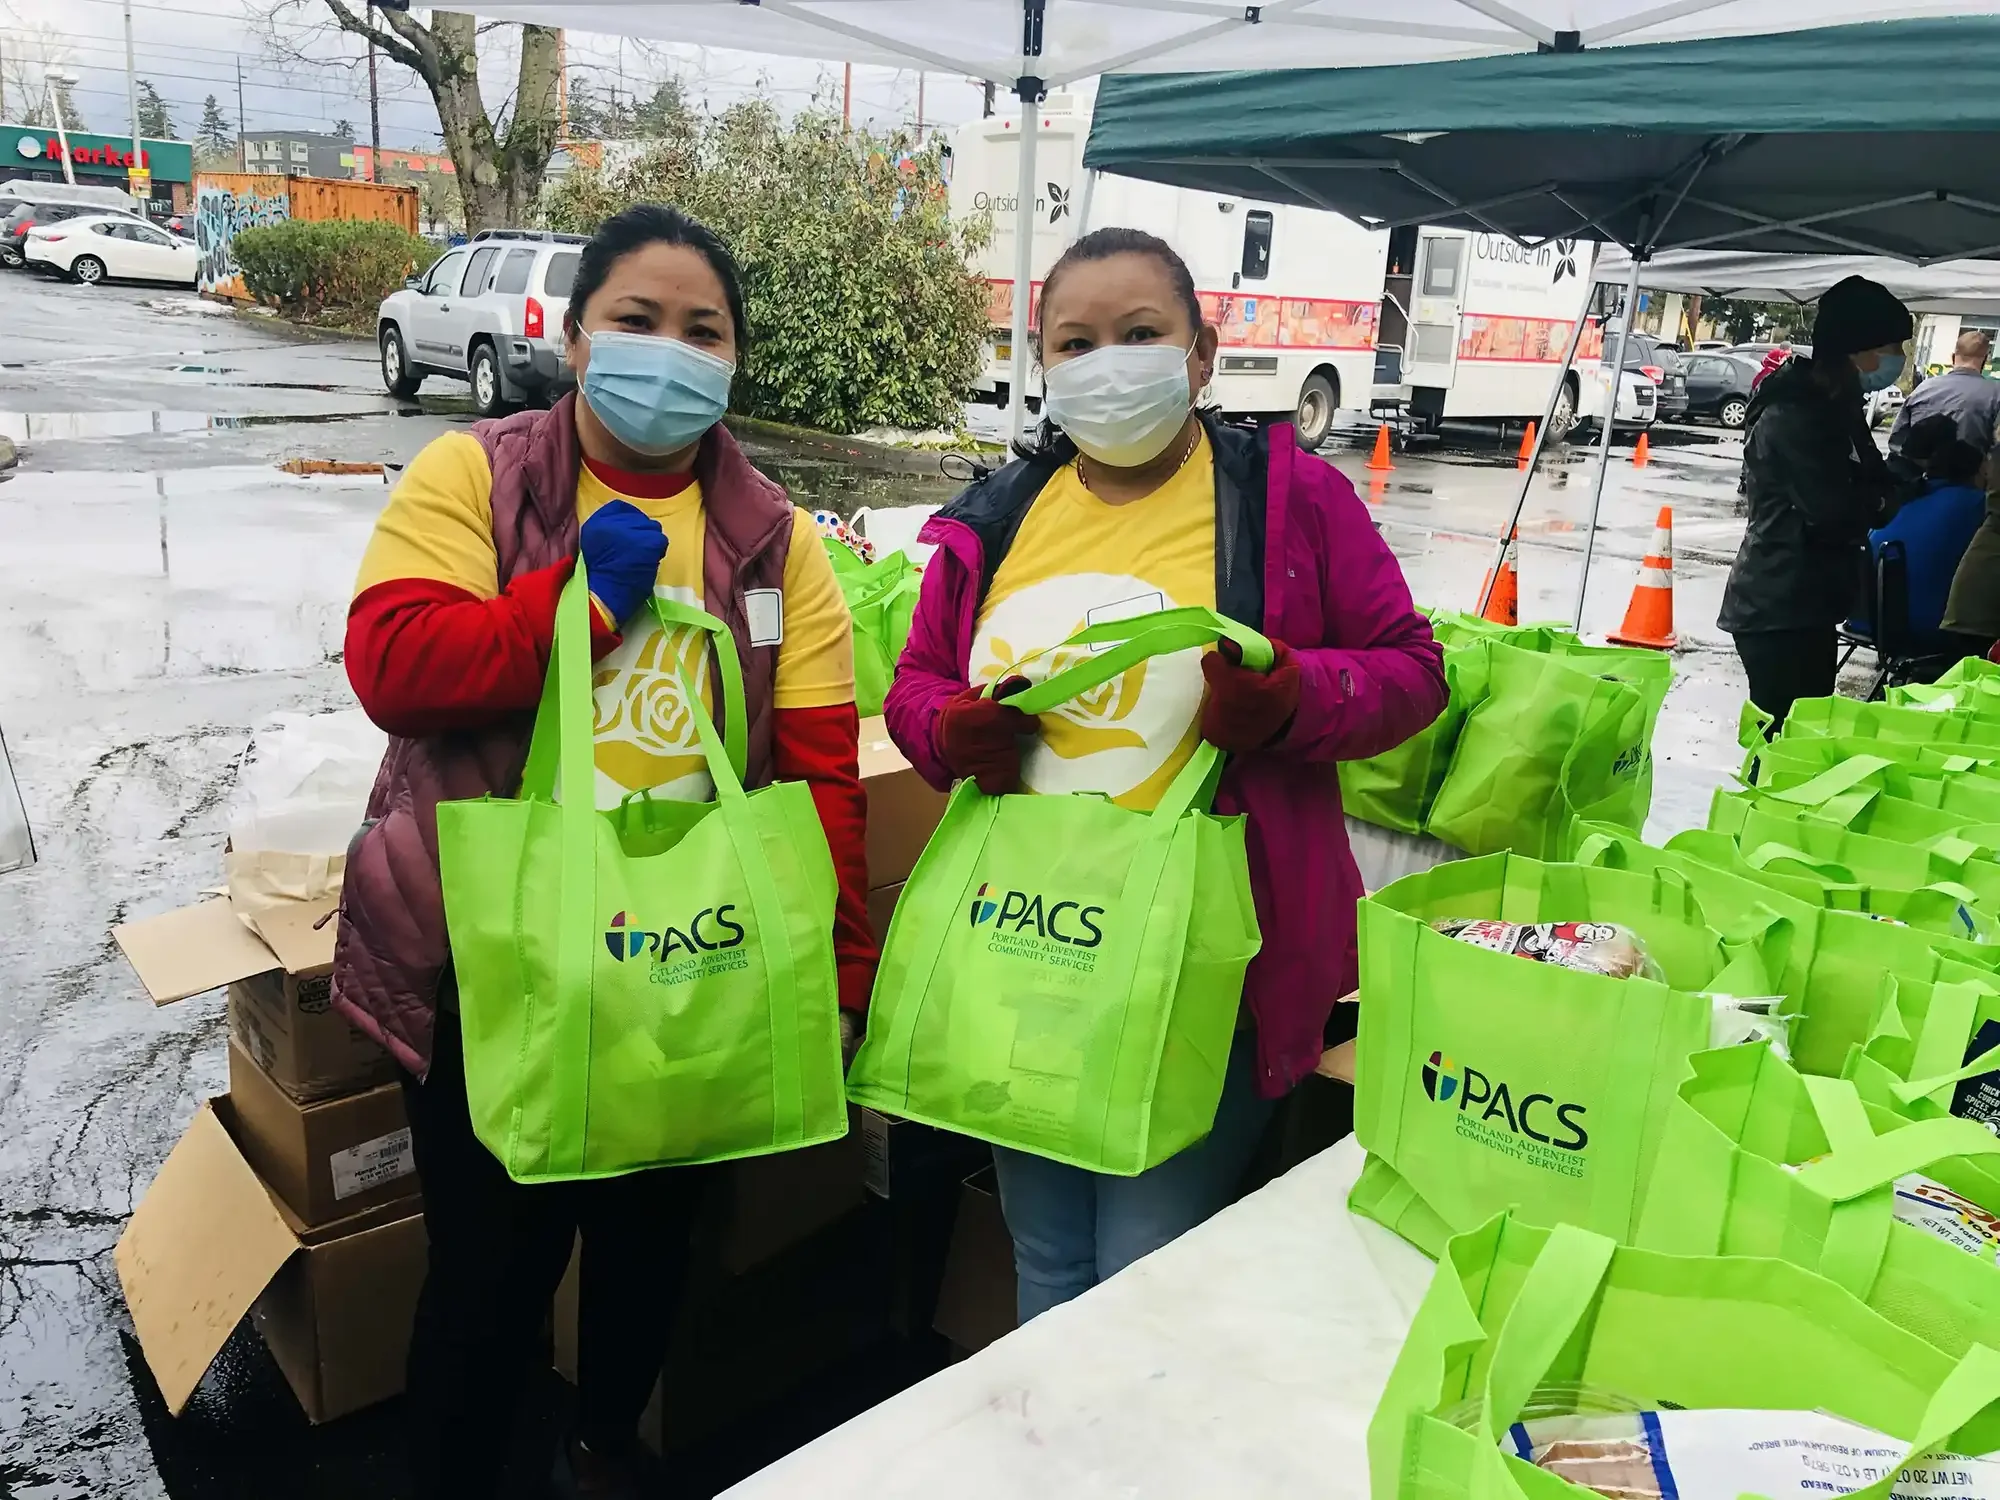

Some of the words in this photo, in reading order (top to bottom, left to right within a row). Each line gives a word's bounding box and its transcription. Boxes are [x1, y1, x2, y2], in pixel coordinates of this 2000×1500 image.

[974, 191, 1020, 212] Outsid
[1477, 232, 1532, 265] Outside
[1536, 245, 1551, 267] In
[996, 891, 1105, 948] PACS
[991, 932, 1039, 949] PORTLAND
[1042, 943, 1098, 962] ADVENTIST
[701, 949, 747, 966] ADVENTIST
[988, 942, 1046, 962] COMMUNITY
[1049, 955, 1095, 973] SERVICES
[708, 960, 749, 976] SERVICES
[1980, 1082, 2000, 1098] THICK
[1964, 1094, 1990, 1114] SPICES,
[1978, 1091, 2000, 1108] CURED
[1459, 1066, 1588, 1151] PACS
[1967, 1106, 1988, 1120] EXTR
[1457, 1113, 1513, 1144] PORTLAND
[1518, 1140, 1586, 1167] ADVENTIST
[1456, 1125, 1523, 1159] COMMUNITY
[1527, 1155, 1583, 1178] SERVICES
[1937, 1225, 1953, 1239] WT
[1950, 1235, 1965, 1247] 20
[1811, 1442, 1848, 1455] REGULAR
[1851, 1447, 1861, 1457] OF
[1864, 1448, 1901, 1459] CALCIUM
[1801, 1454, 1830, 1473] 567g
[1832, 1462, 1851, 1477] OZ)
[1852, 1467, 1860, 1479] 4
[1863, 1467, 1879, 1481] LB
[1913, 1469, 1927, 1484] 20
[1931, 1470, 1949, 1485] WT
[1952, 1471, 1973, 1485] NET
[1800, 1479, 1835, 1492] BREAD
